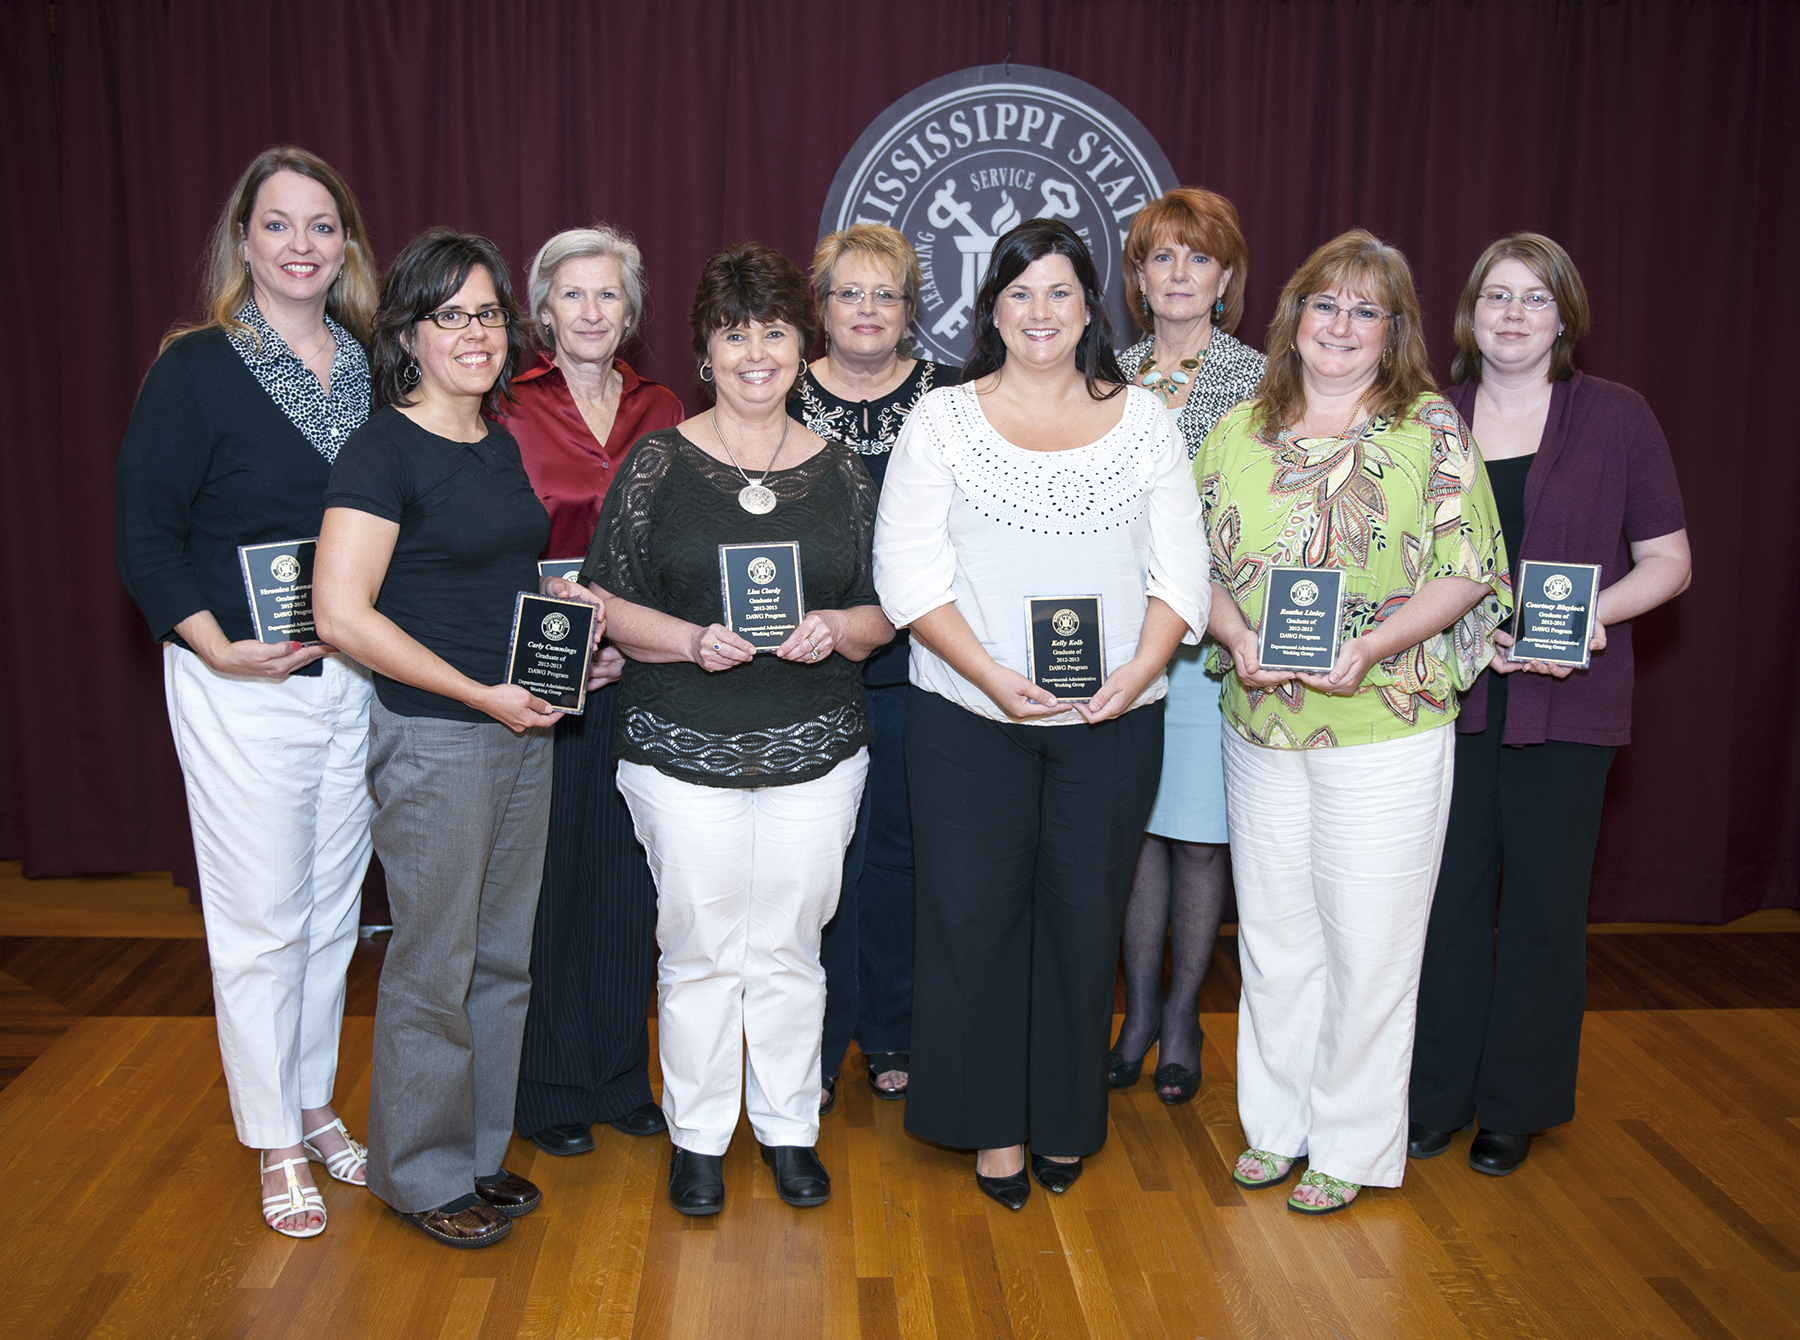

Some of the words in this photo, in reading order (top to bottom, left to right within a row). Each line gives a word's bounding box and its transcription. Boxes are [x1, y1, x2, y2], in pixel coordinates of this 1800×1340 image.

[969, 167, 1036, 192] SERVICE
[914, 230, 936, 312] LEARNING
[1526, 602, 1555, 610] Courtney
[528, 641, 544, 650] Carly
[545, 644, 577, 655] Cummings
[535, 652, 559, 661] Graduate
[518, 679, 544, 687] Departmental
